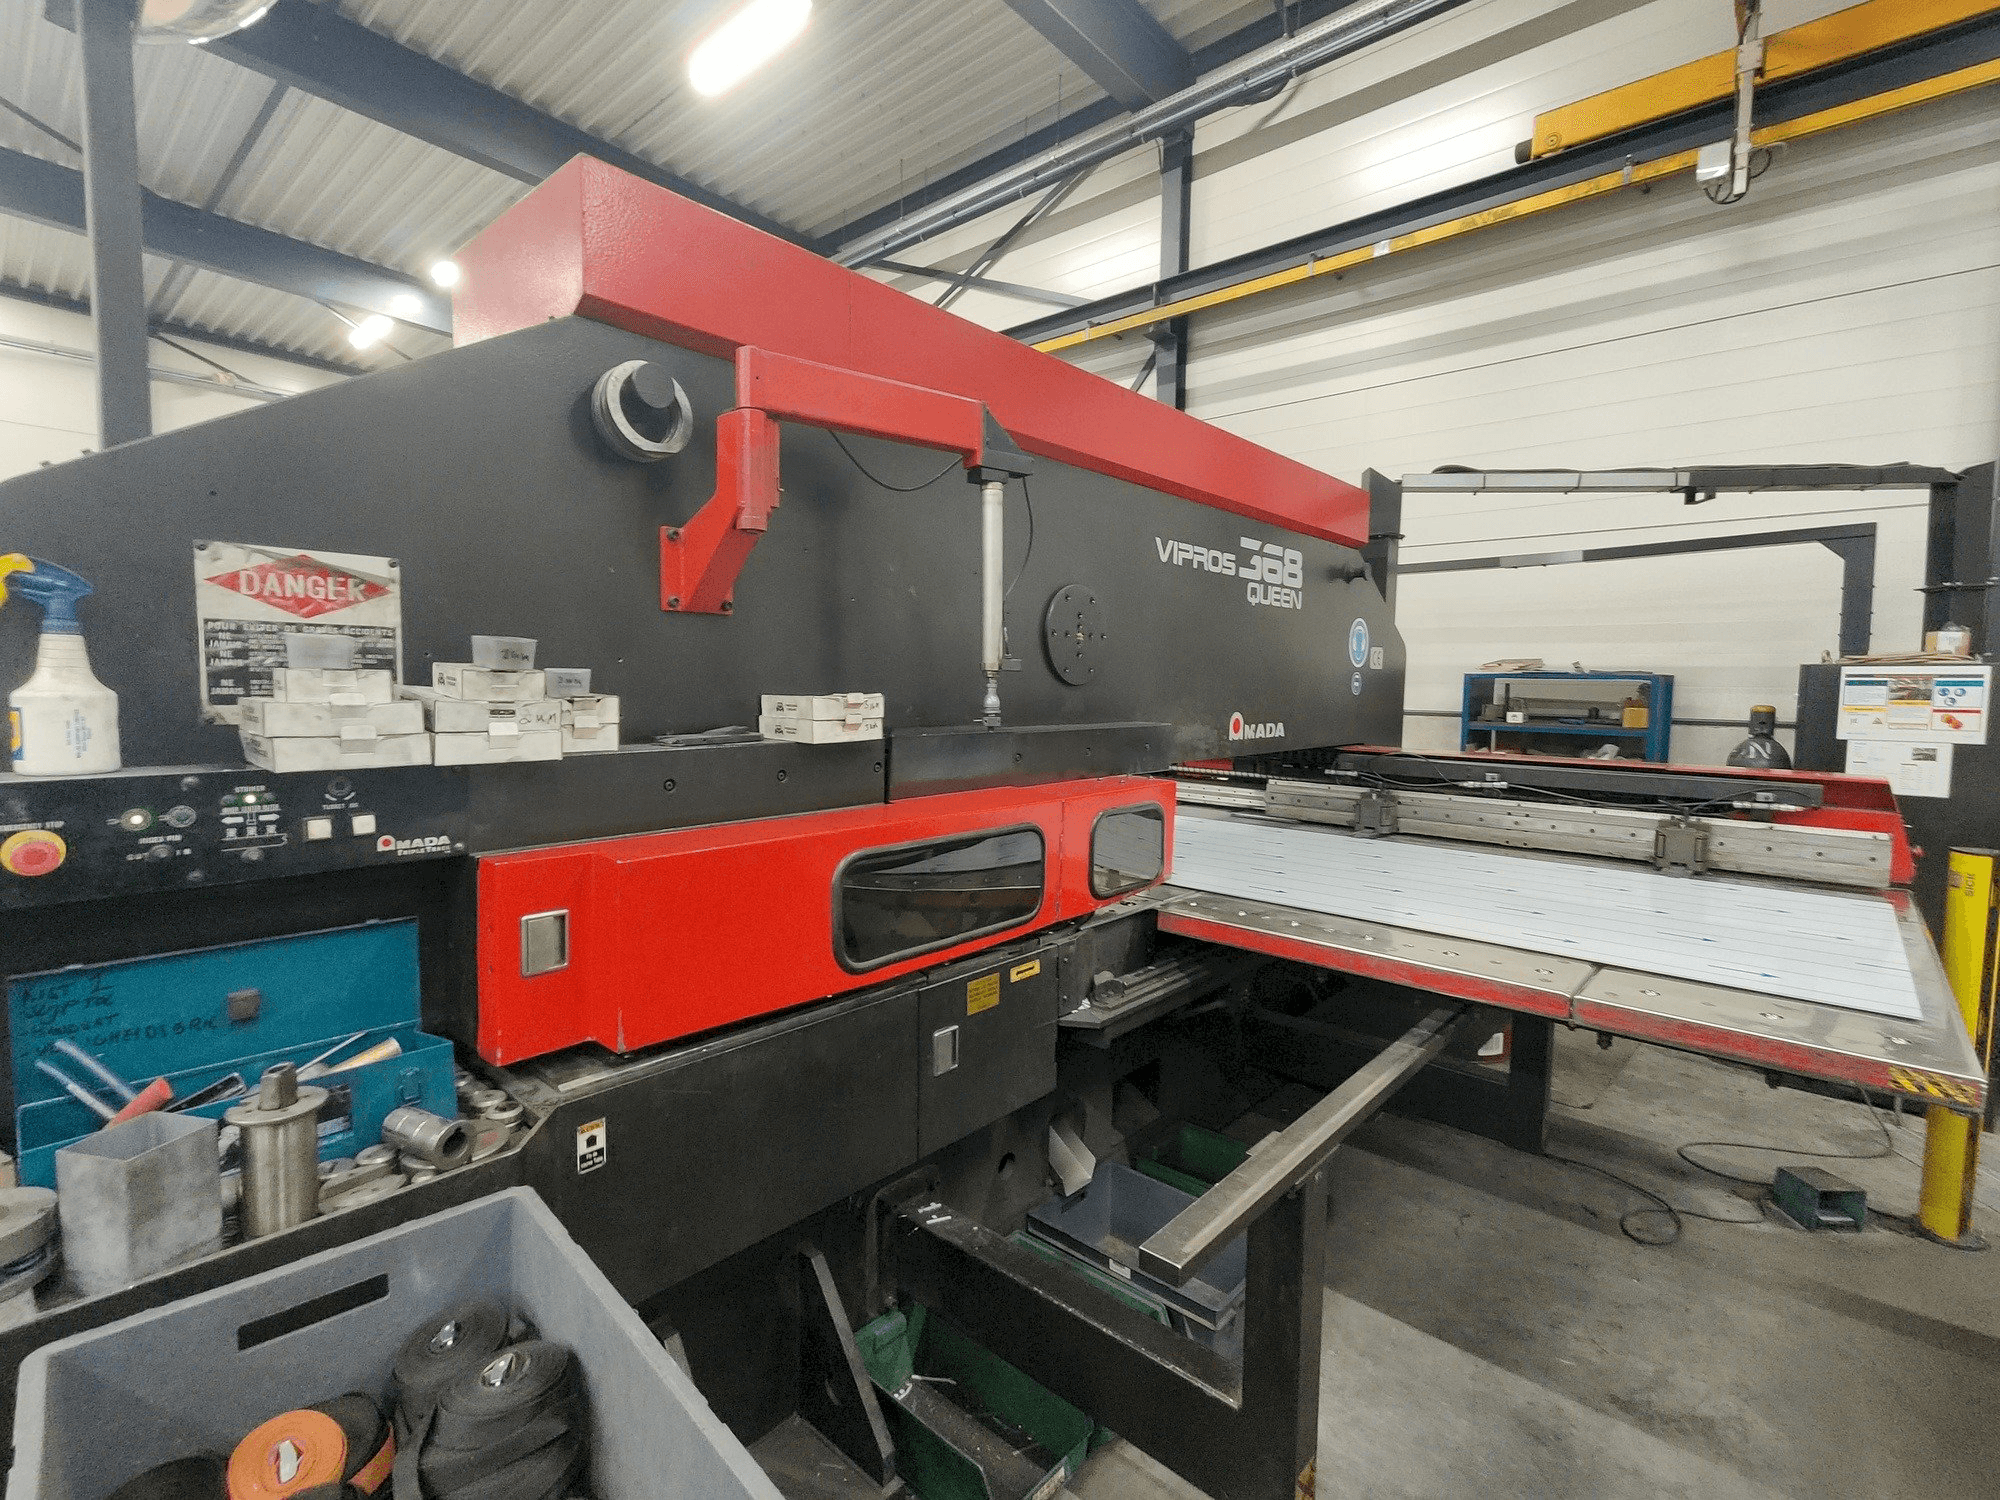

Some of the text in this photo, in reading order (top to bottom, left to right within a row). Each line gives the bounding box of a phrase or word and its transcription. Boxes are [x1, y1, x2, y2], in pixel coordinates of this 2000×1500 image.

[1154, 536, 1303, 588] VIPROS 368
[1247, 582, 1302, 610] QUEEN
[1229, 711, 1285, 740] AMADA
[377, 835, 451, 852] AMADA
